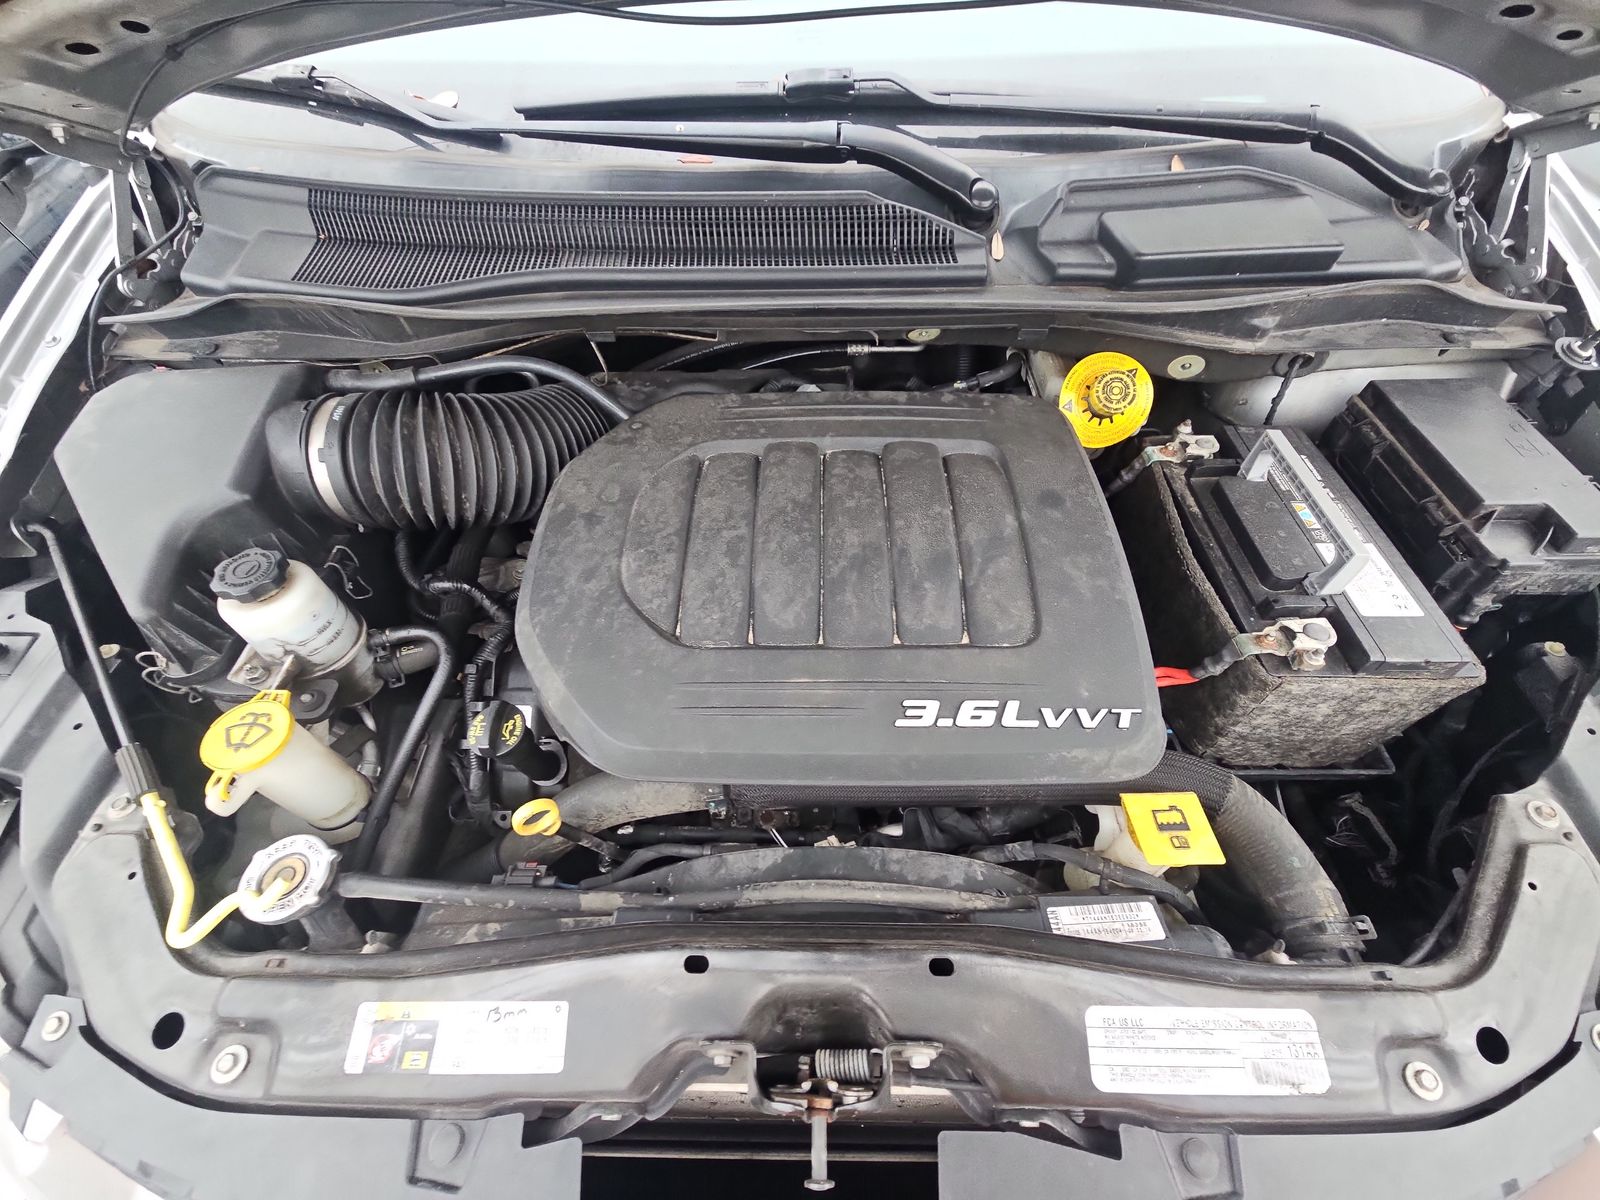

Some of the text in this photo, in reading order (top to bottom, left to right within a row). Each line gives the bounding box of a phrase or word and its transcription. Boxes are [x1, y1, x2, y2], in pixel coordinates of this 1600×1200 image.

[506, 713, 523, 746] ENGINE OIL
[894, 699, 1142, 730] 3.6L VVT
[1130, 1017, 1144, 1027] LLC
